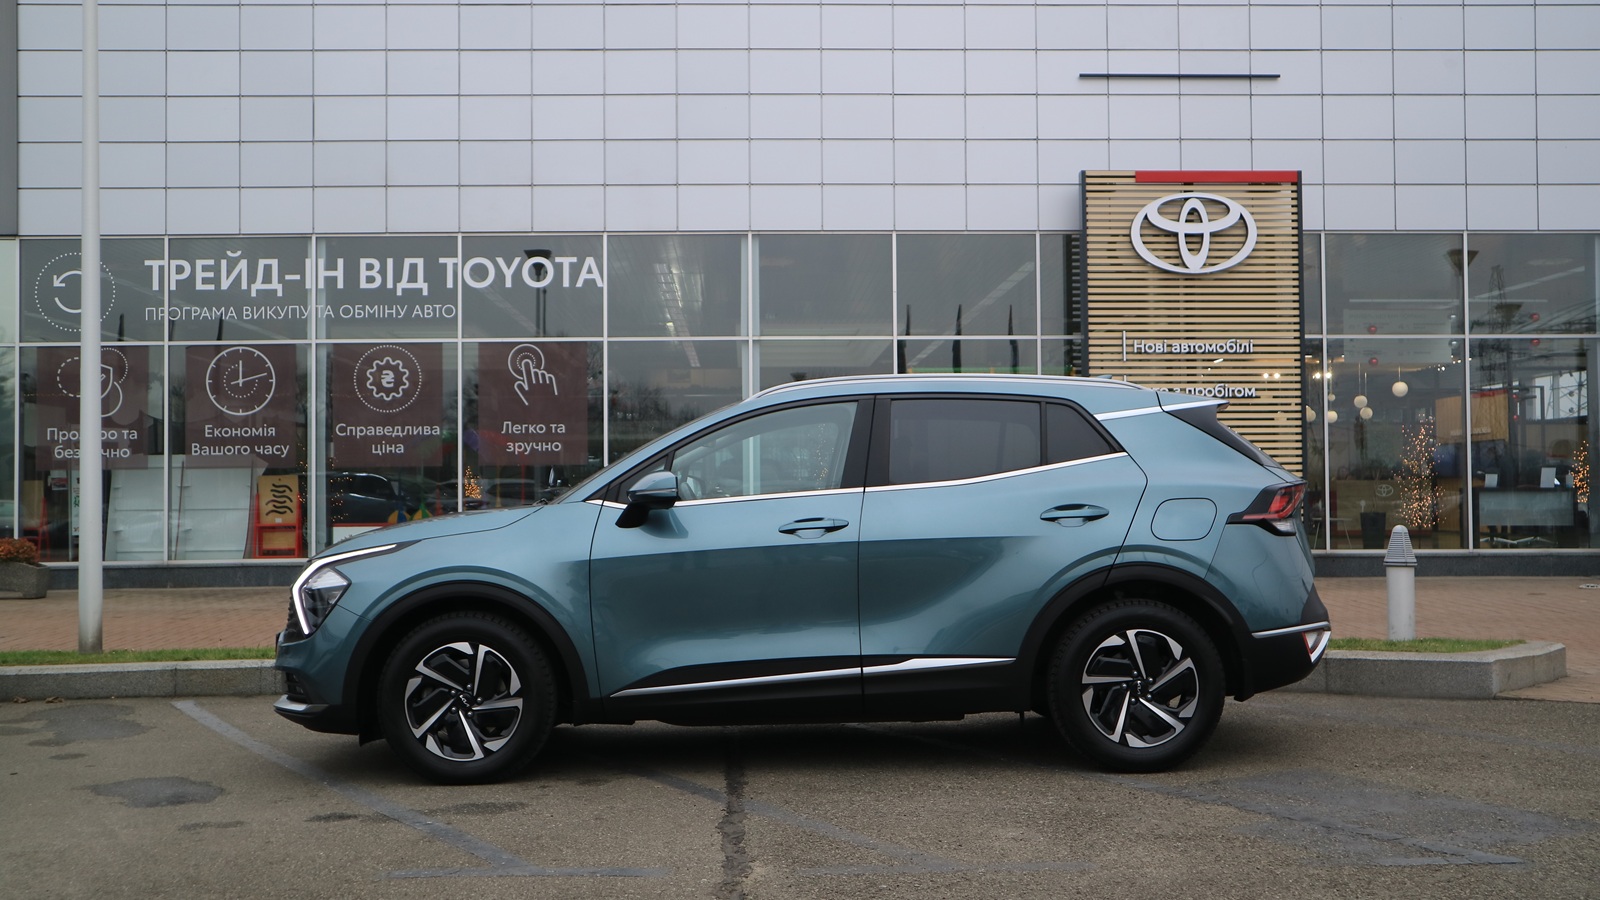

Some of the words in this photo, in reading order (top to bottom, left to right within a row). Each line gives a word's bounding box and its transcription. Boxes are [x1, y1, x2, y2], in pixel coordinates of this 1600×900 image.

[144, 250, 344, 297] ТРЕЙД-ІН
[359, 257, 429, 296] ВІД
[439, 256, 604, 289] TOYOTA
[145, 306, 237, 321] ПРОГРАМА
[243, 305, 311, 320] ВИКУПУ
[315, 305, 335, 318] ТА
[339, 304, 408, 319] ОБМІНУ
[411, 304, 456, 318] АВТО
[1134, 339, 1167, 353] Нові
[1172, 338, 1254, 353] автомобілі
[1186, 383, 1256, 398] пробігом
[47, 427, 118, 444] Проо
[121, 429, 138, 440] та
[204, 424, 276, 438] Економія
[335, 423, 440, 439] Справедлива
[501, 421, 546, 435] Легко
[549, 422, 566, 434] та
[54, 445, 130, 458] безчно
[191, 443, 250, 456] Вашого
[254, 445, 290, 458] часу
[371, 440, 404, 455] ціна
[506, 440, 562, 454] зручно
